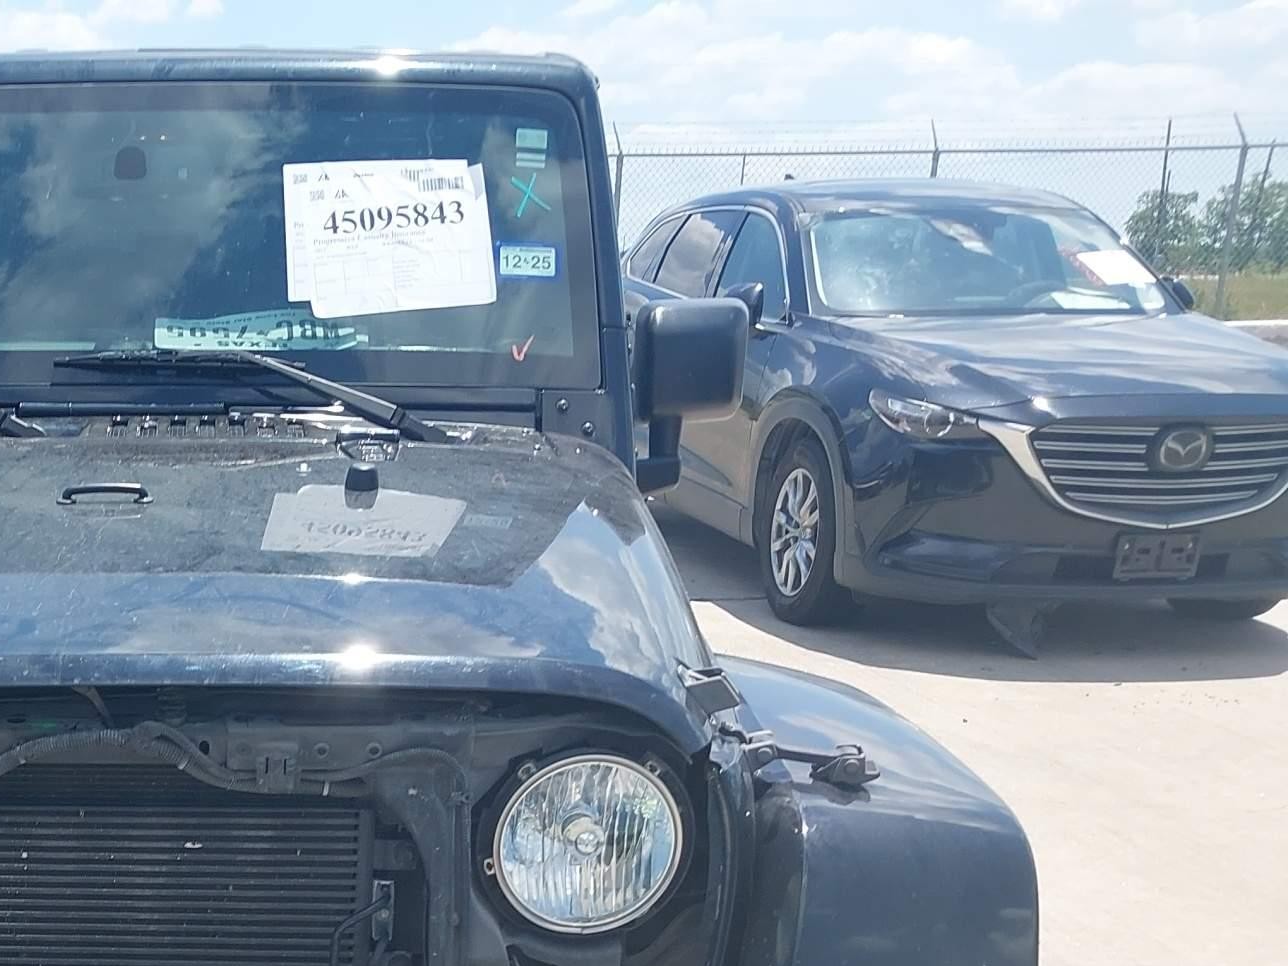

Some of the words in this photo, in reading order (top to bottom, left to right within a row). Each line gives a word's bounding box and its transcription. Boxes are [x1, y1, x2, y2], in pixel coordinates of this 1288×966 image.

[323, 200, 465, 235] 45095843
[502, 254, 522, 269] 12
[531, 255, 552, 270] 25
